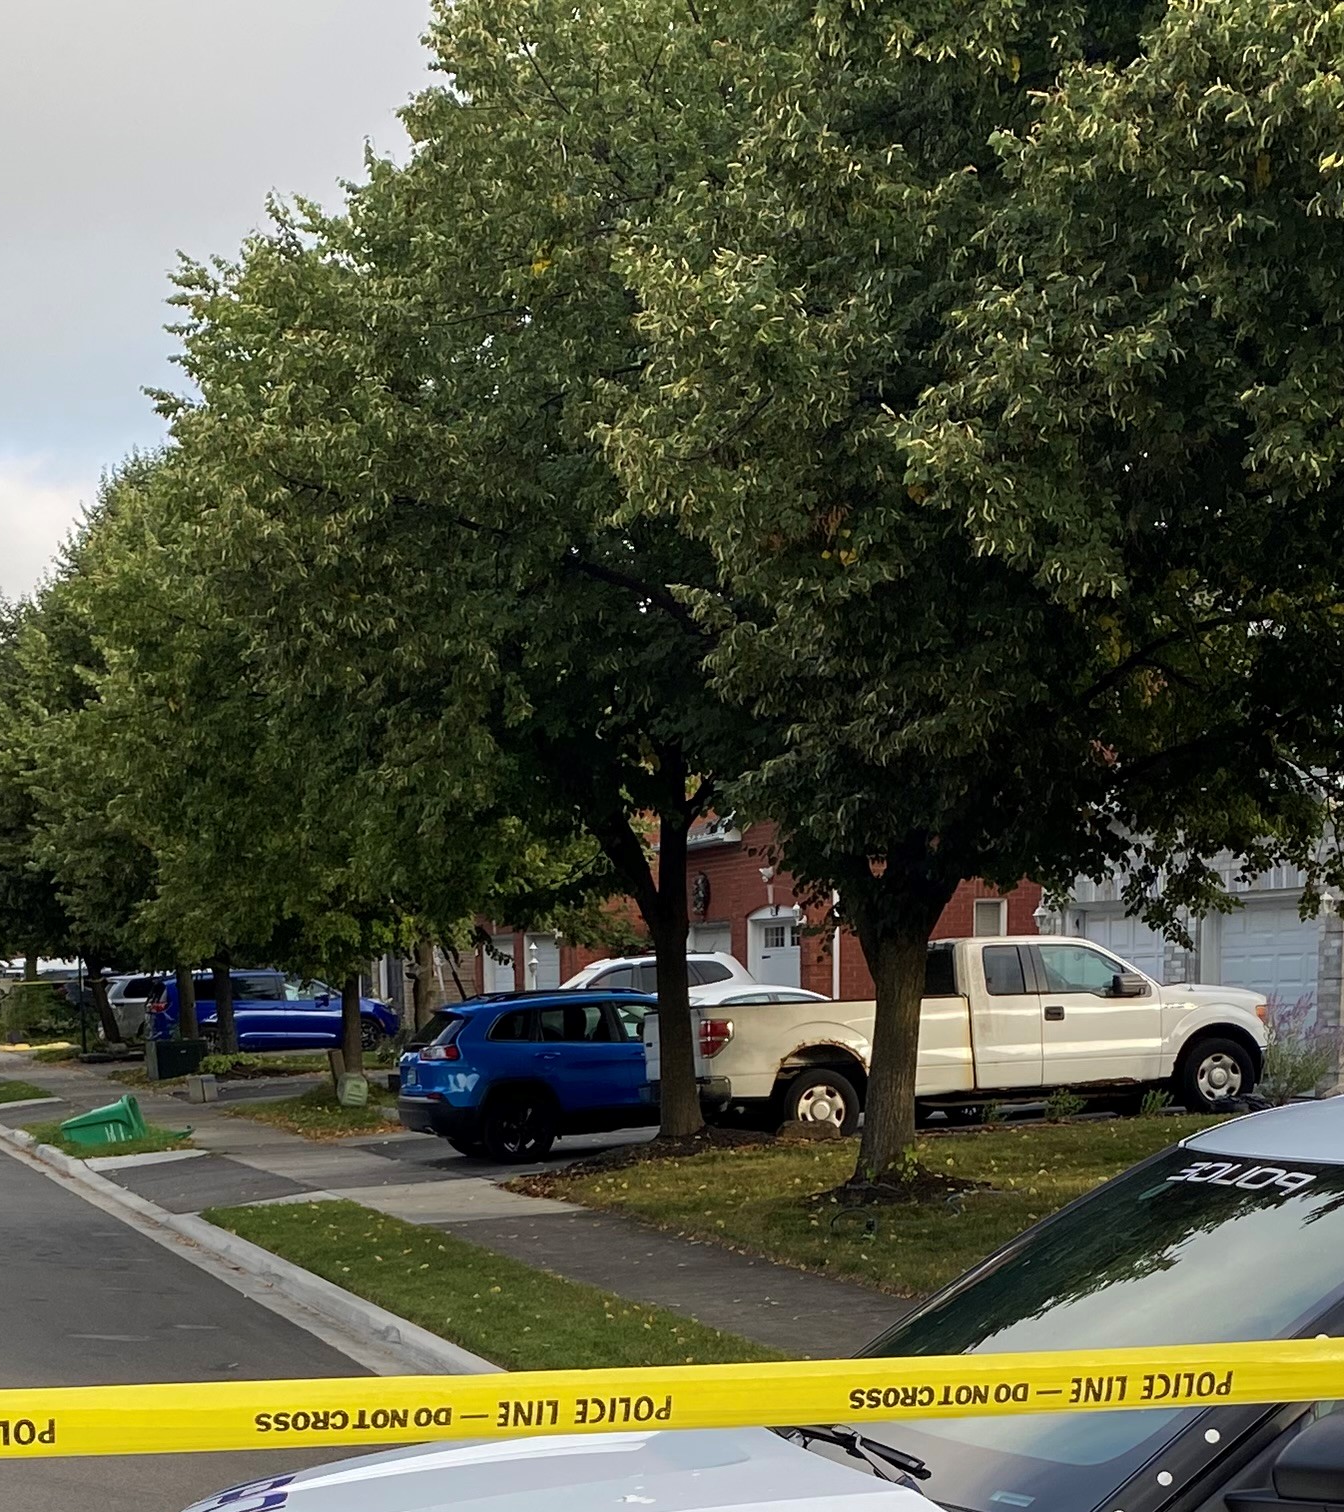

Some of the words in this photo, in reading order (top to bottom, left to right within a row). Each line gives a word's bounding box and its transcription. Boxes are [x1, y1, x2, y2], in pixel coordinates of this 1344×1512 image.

[848, 1385, 936, 1410] CROSS
[937, 1384, 989, 1406] NOT
[989, 1383, 1029, 1404] DO
[1069, 1375, 1128, 1404] LINE
[1141, 1370, 1234, 1401] POLICE
[254, 1409, 350, 1433] CROSS
[354, 1409, 408, 1430] NOT
[413, 1407, 453, 1427] DO
[496, 1399, 559, 1427] LINE
[574, 1395, 674, 1424] POLICE
